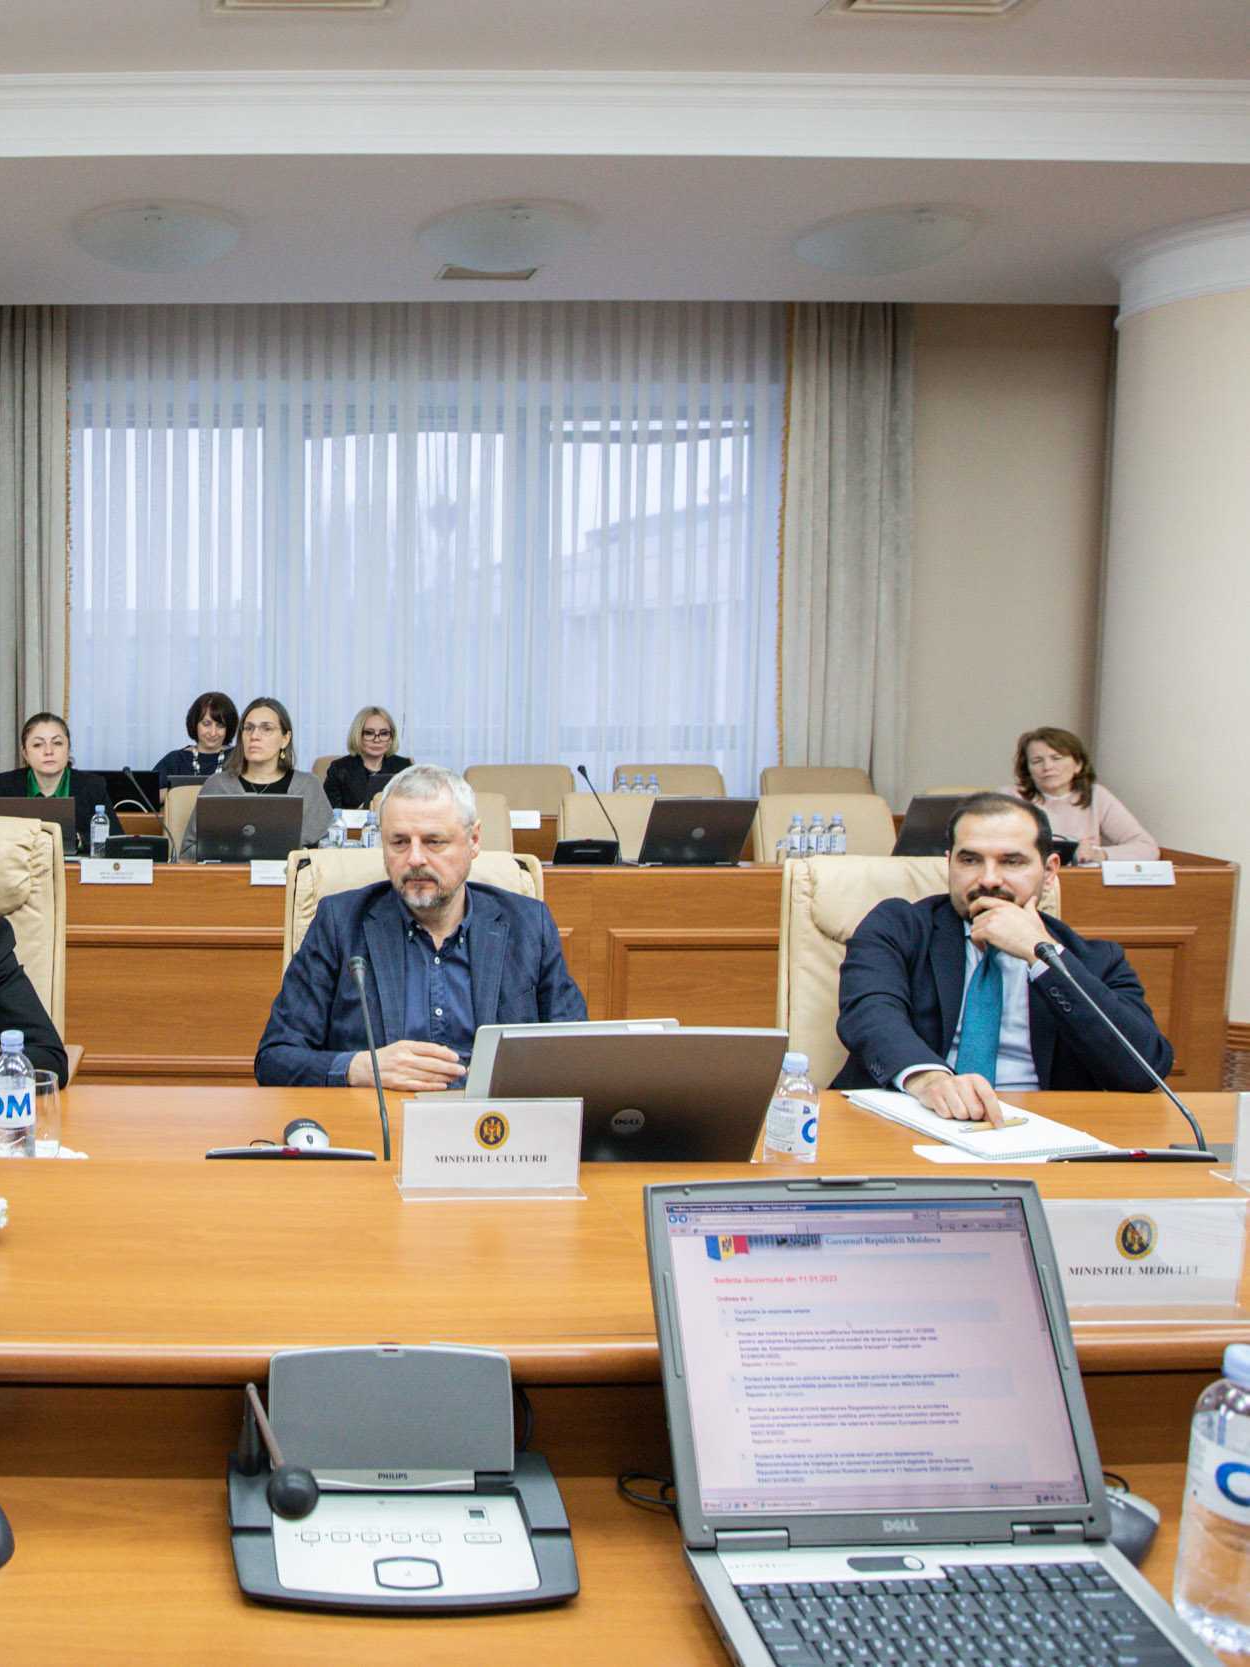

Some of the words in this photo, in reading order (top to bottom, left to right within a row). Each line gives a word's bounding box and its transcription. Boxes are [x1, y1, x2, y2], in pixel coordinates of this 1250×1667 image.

[435, 1154, 491, 1163] MINISTRUL
[495, 1154, 548, 1163] CULTURII
[1070, 1265, 1133, 1276] MINISTRUL
[1139, 1264, 1199, 1275] MEDIULUI
[378, 1472, 408, 1480] PHILIPS
[882, 1518, 919, 1532] DELL
